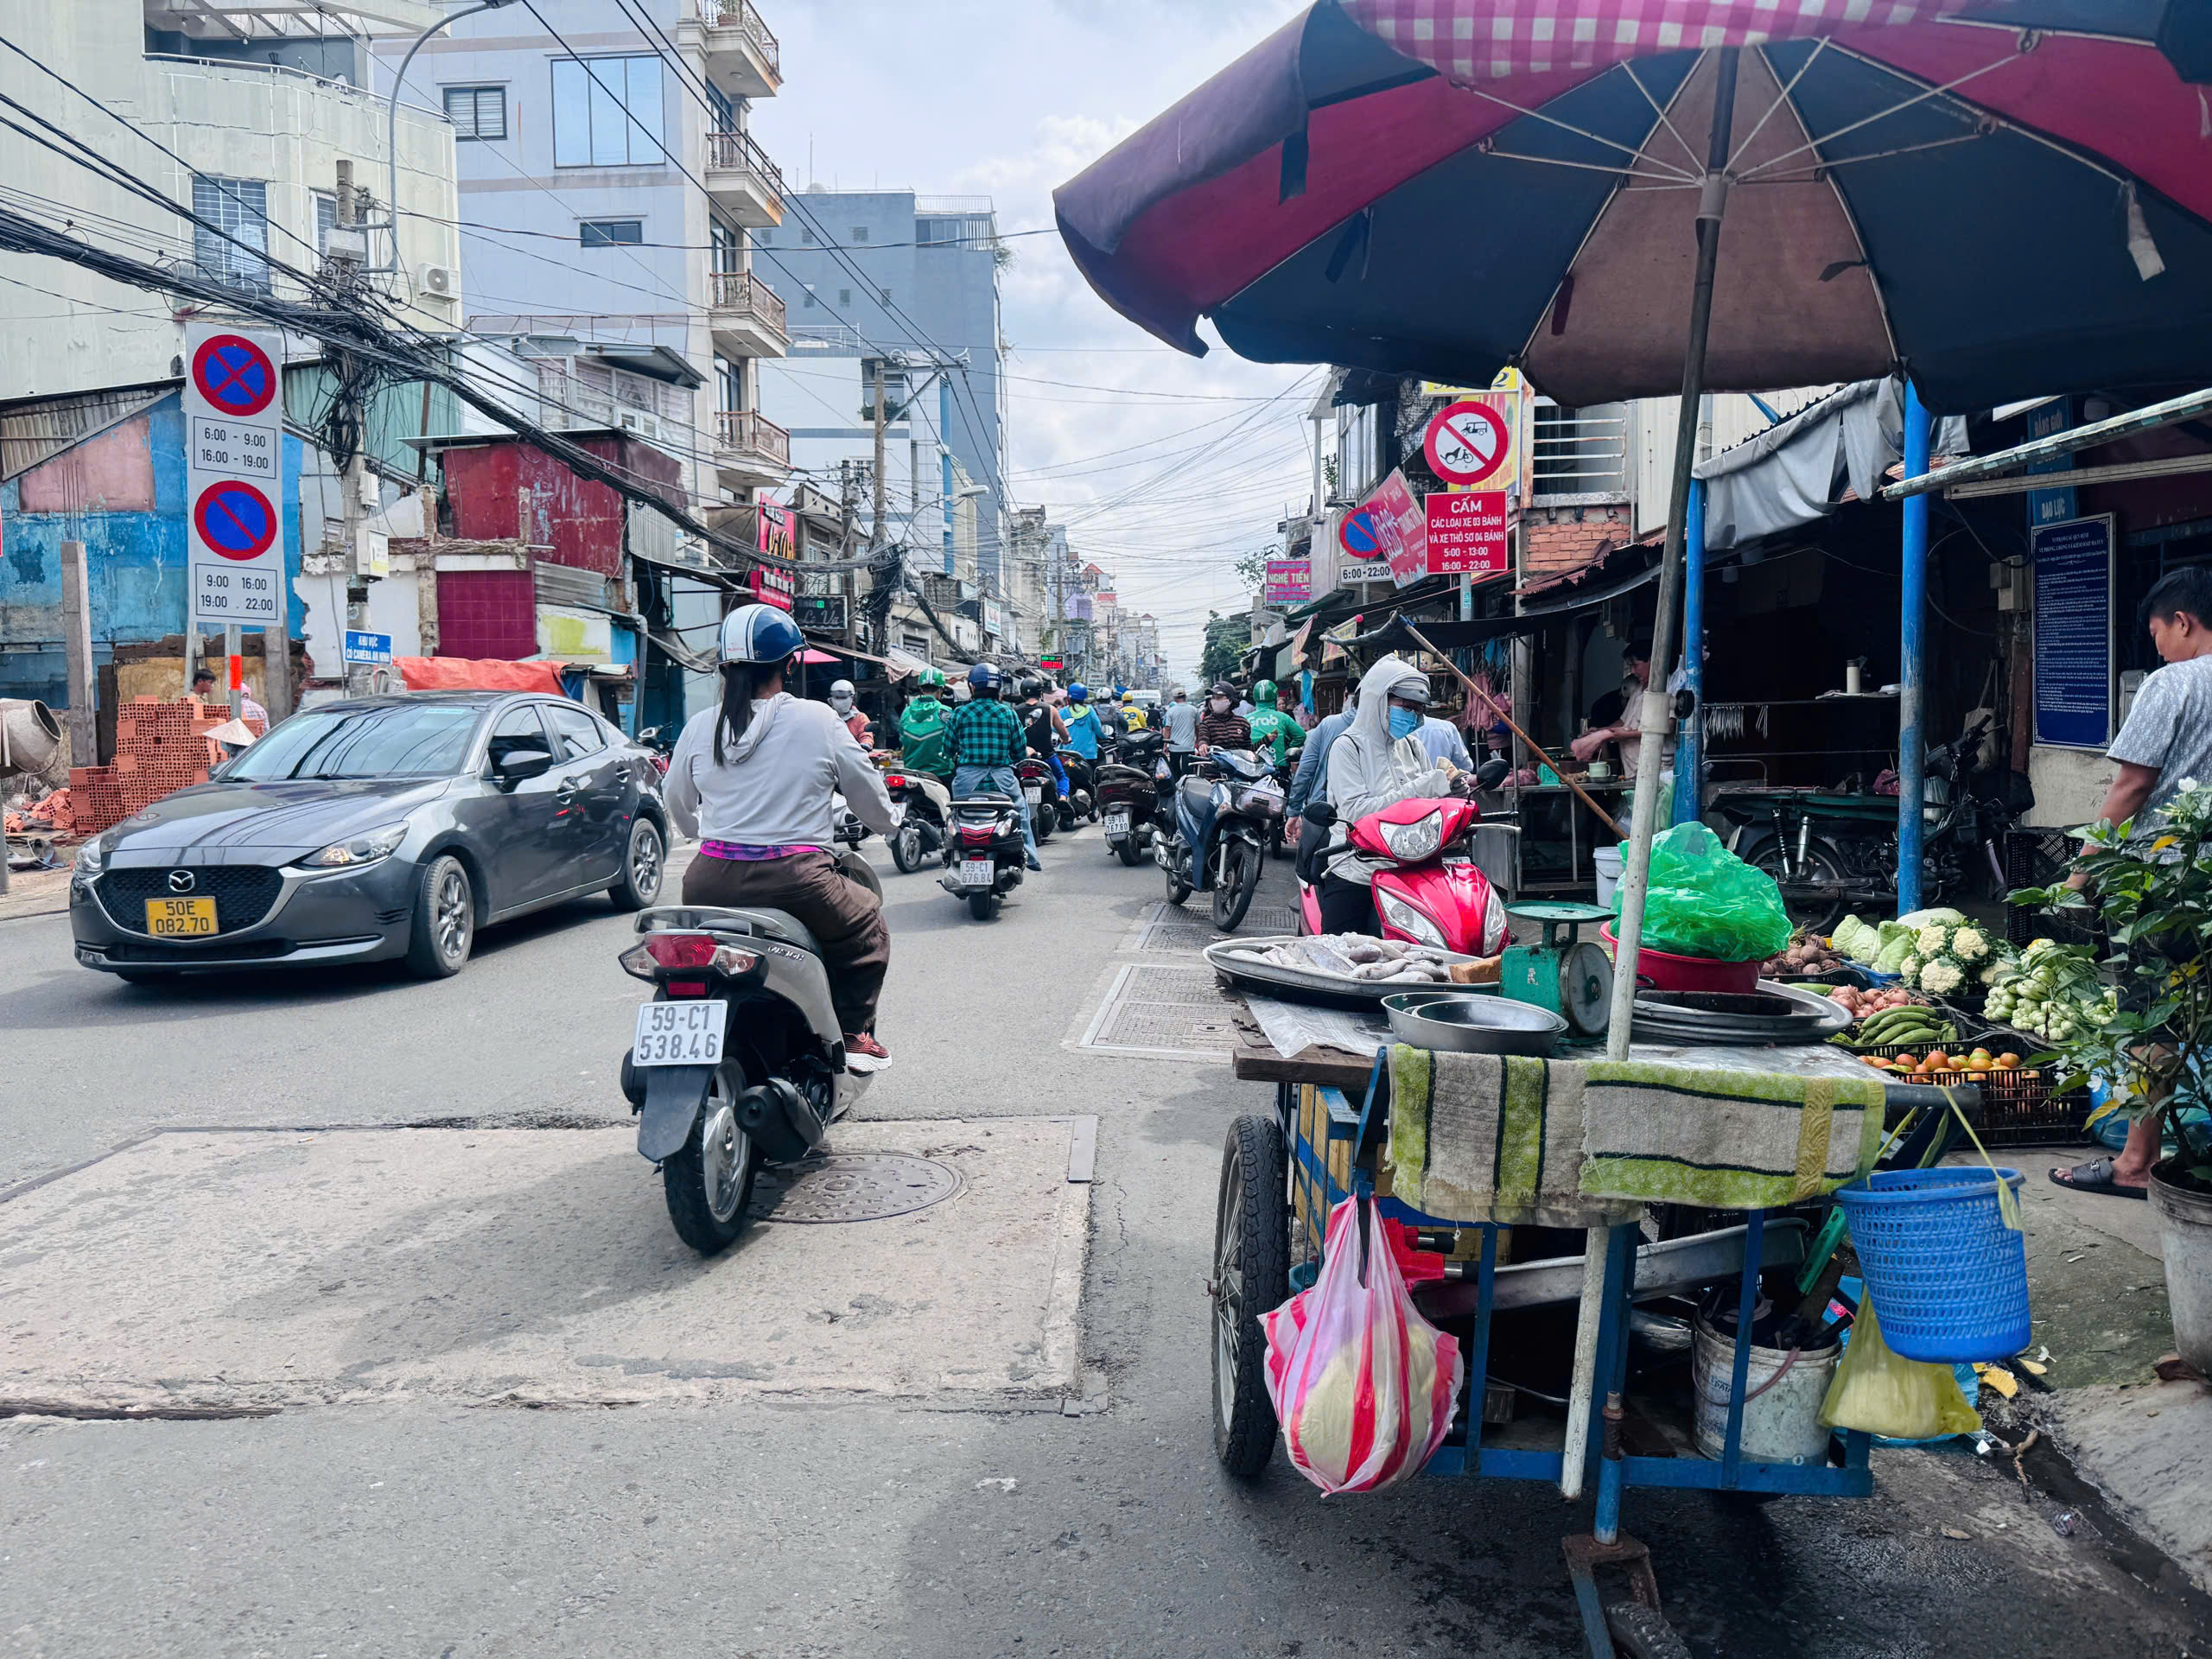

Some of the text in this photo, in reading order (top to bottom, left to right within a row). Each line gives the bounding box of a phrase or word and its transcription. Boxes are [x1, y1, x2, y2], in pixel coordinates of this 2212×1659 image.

[204, 427, 226, 442] 6:00
[244, 433, 266, 448] 9:00
[201, 448, 228, 463] 16:00
[243, 454, 269, 469] 19:00
[1451, 496, 1483, 513] CẤM
[1431, 514, 1502, 530] CÁC LOẠI XE 03 BÁNH
[1429, 532, 1439, 543] VÀ
[1440, 533, 1449, 543] XE
[1449, 531, 1464, 543] THÔ
[1475, 532, 1483, 541] 04
[1484, 530, 1504, 541] BÁNH
[1444, 548, 1460, 557] 5:00
[1468, 547, 1488, 556] 13:00
[1442, 562, 1461, 570] 16:00
[1469, 560, 1490, 569] 22:00
[207, 575, 267, 590] 9:00 16:00
[200, 594, 273, 611] 19:00 22:00
[1248, 715, 1279, 727] Grab
[965, 862, 988, 873] 59-C1
[963, 873, 991, 883] 676.84
[166, 900, 195, 916] 50E
[156, 918, 210, 933] 082.70
[652, 1006, 710, 1032] 59-C1
[639, 1033, 717, 1060] 538.46
